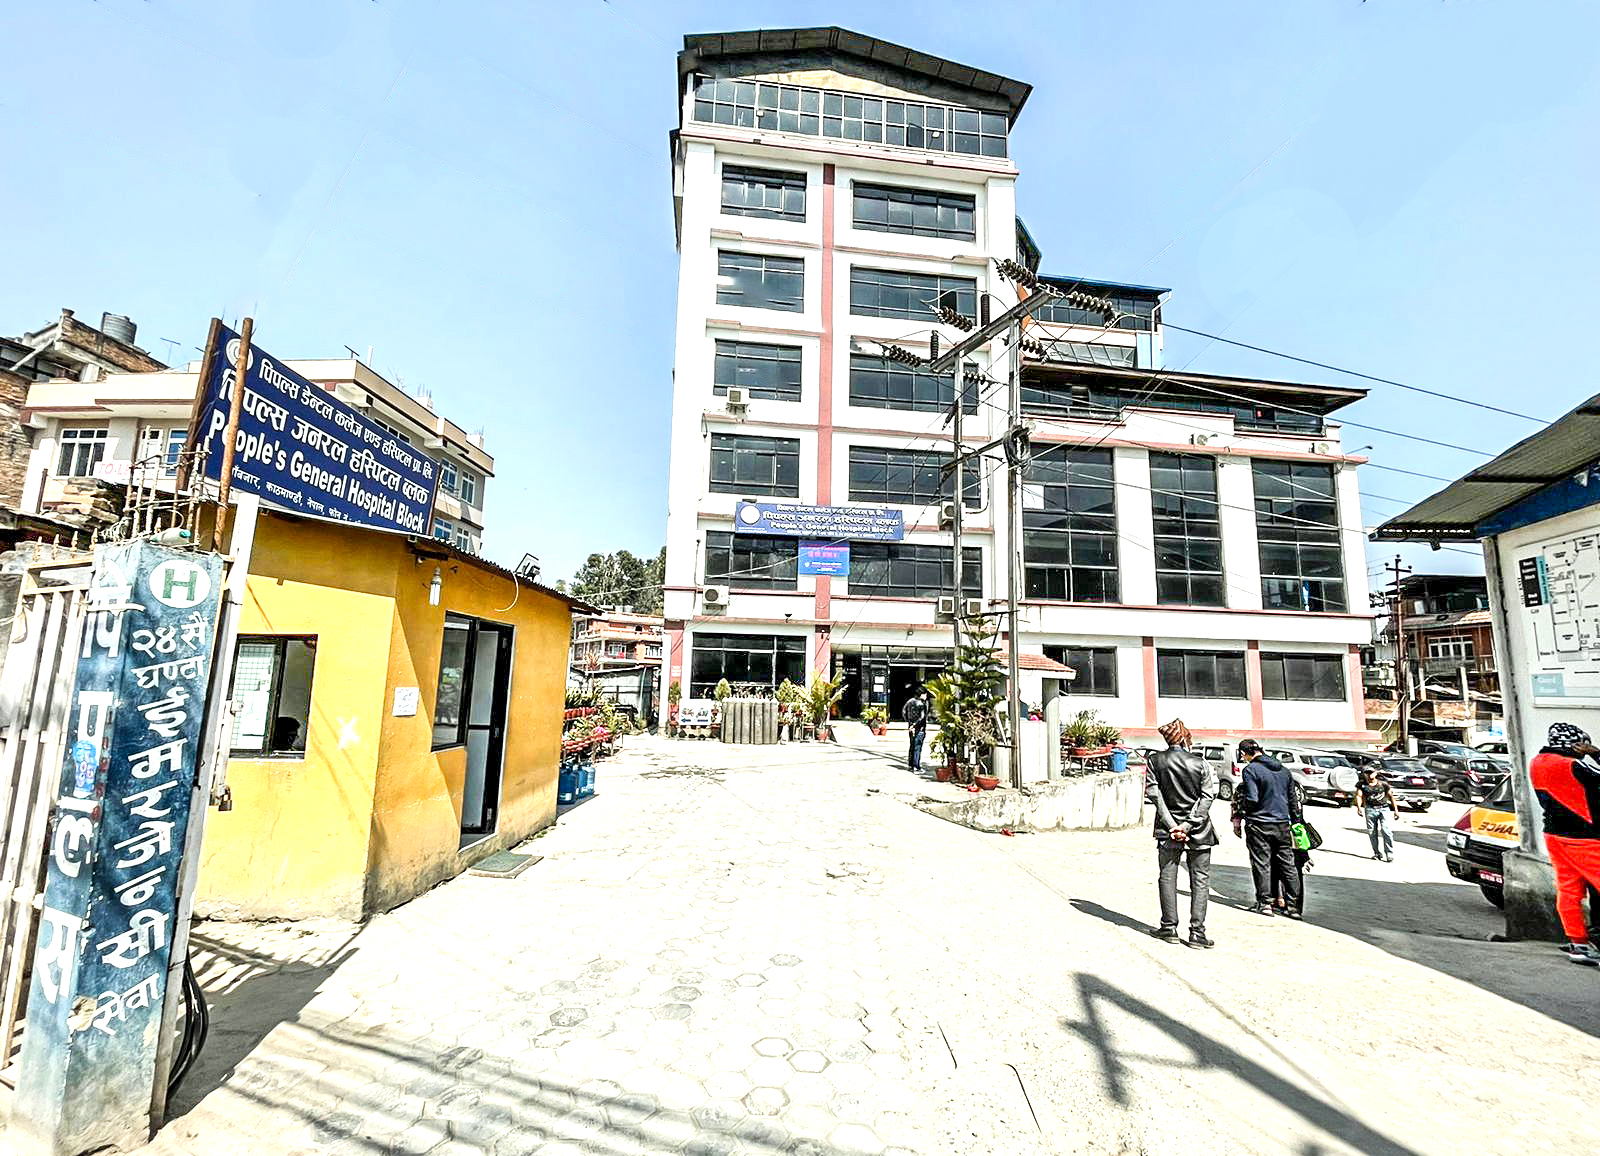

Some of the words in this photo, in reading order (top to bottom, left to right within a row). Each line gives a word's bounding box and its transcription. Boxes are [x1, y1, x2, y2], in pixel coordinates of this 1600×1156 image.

[259, 358, 301, 399] पिपल्स
[301, 385, 334, 420] डेन्टल
[335, 409, 363, 437] कलेज
[290, 415, 349, 463] जनरल
[290, 450, 348, 499] General
[347, 478, 397, 518] Hospital
[396, 501, 424, 534] Block
[770, 521, 804, 530] People's
[805, 523, 838, 532] General
[840, 524, 871, 533] Hospital
[871, 525, 895, 535] Block
[162, 567, 198, 601] H
[92, 972, 164, 1036] सेवा
